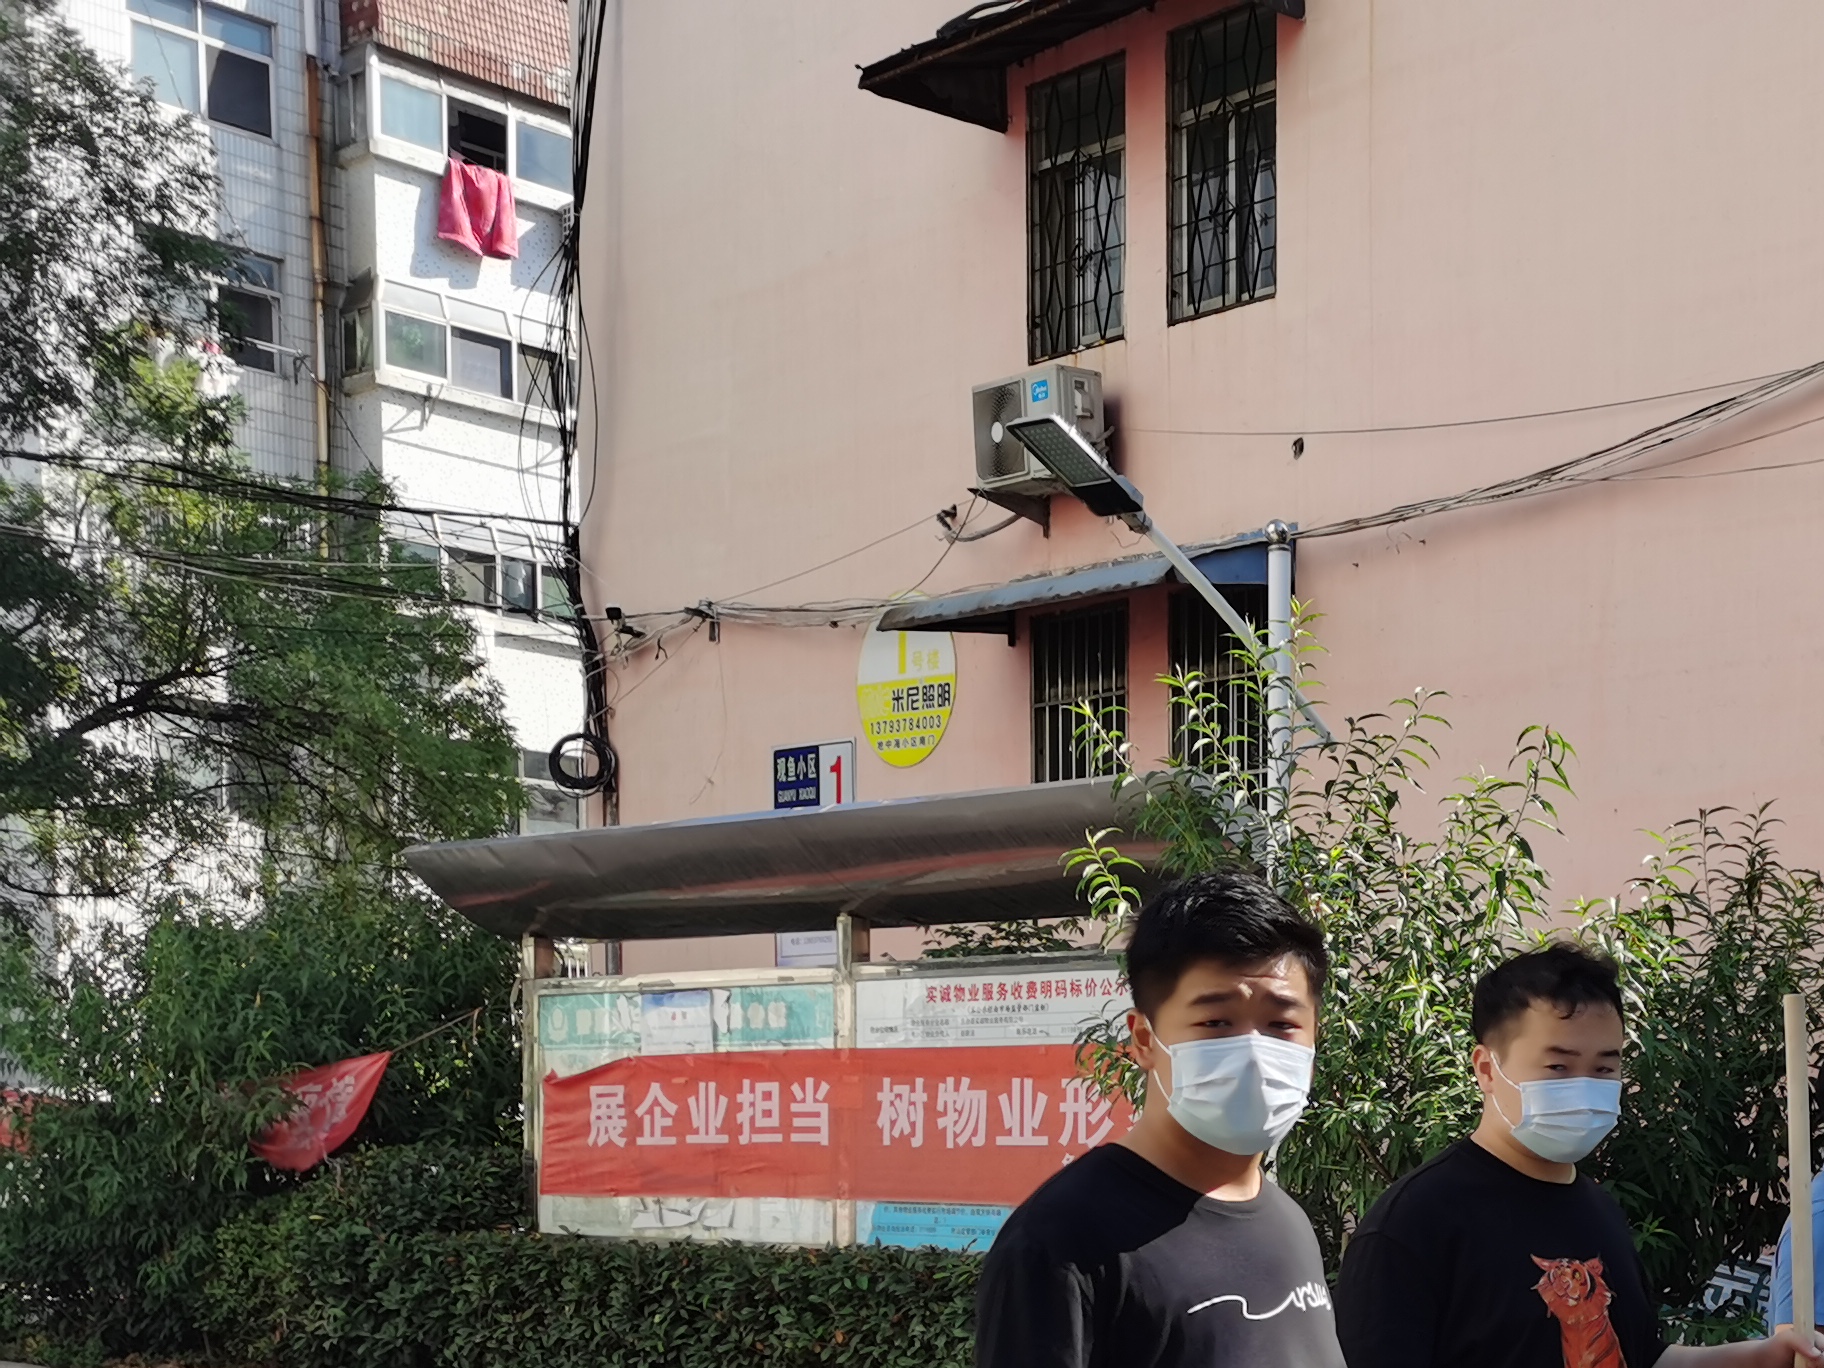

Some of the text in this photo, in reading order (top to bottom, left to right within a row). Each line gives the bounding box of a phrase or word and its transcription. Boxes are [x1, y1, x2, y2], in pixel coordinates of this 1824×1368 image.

[892, 683, 951, 712] 米尼照明
[870, 715, 942, 735] 13793784003
[777, 753, 817, 782] 观鱼小区
[829, 755, 842, 804] 1
[588, 1076, 1143, 1149] 展企业担当 树物业形
